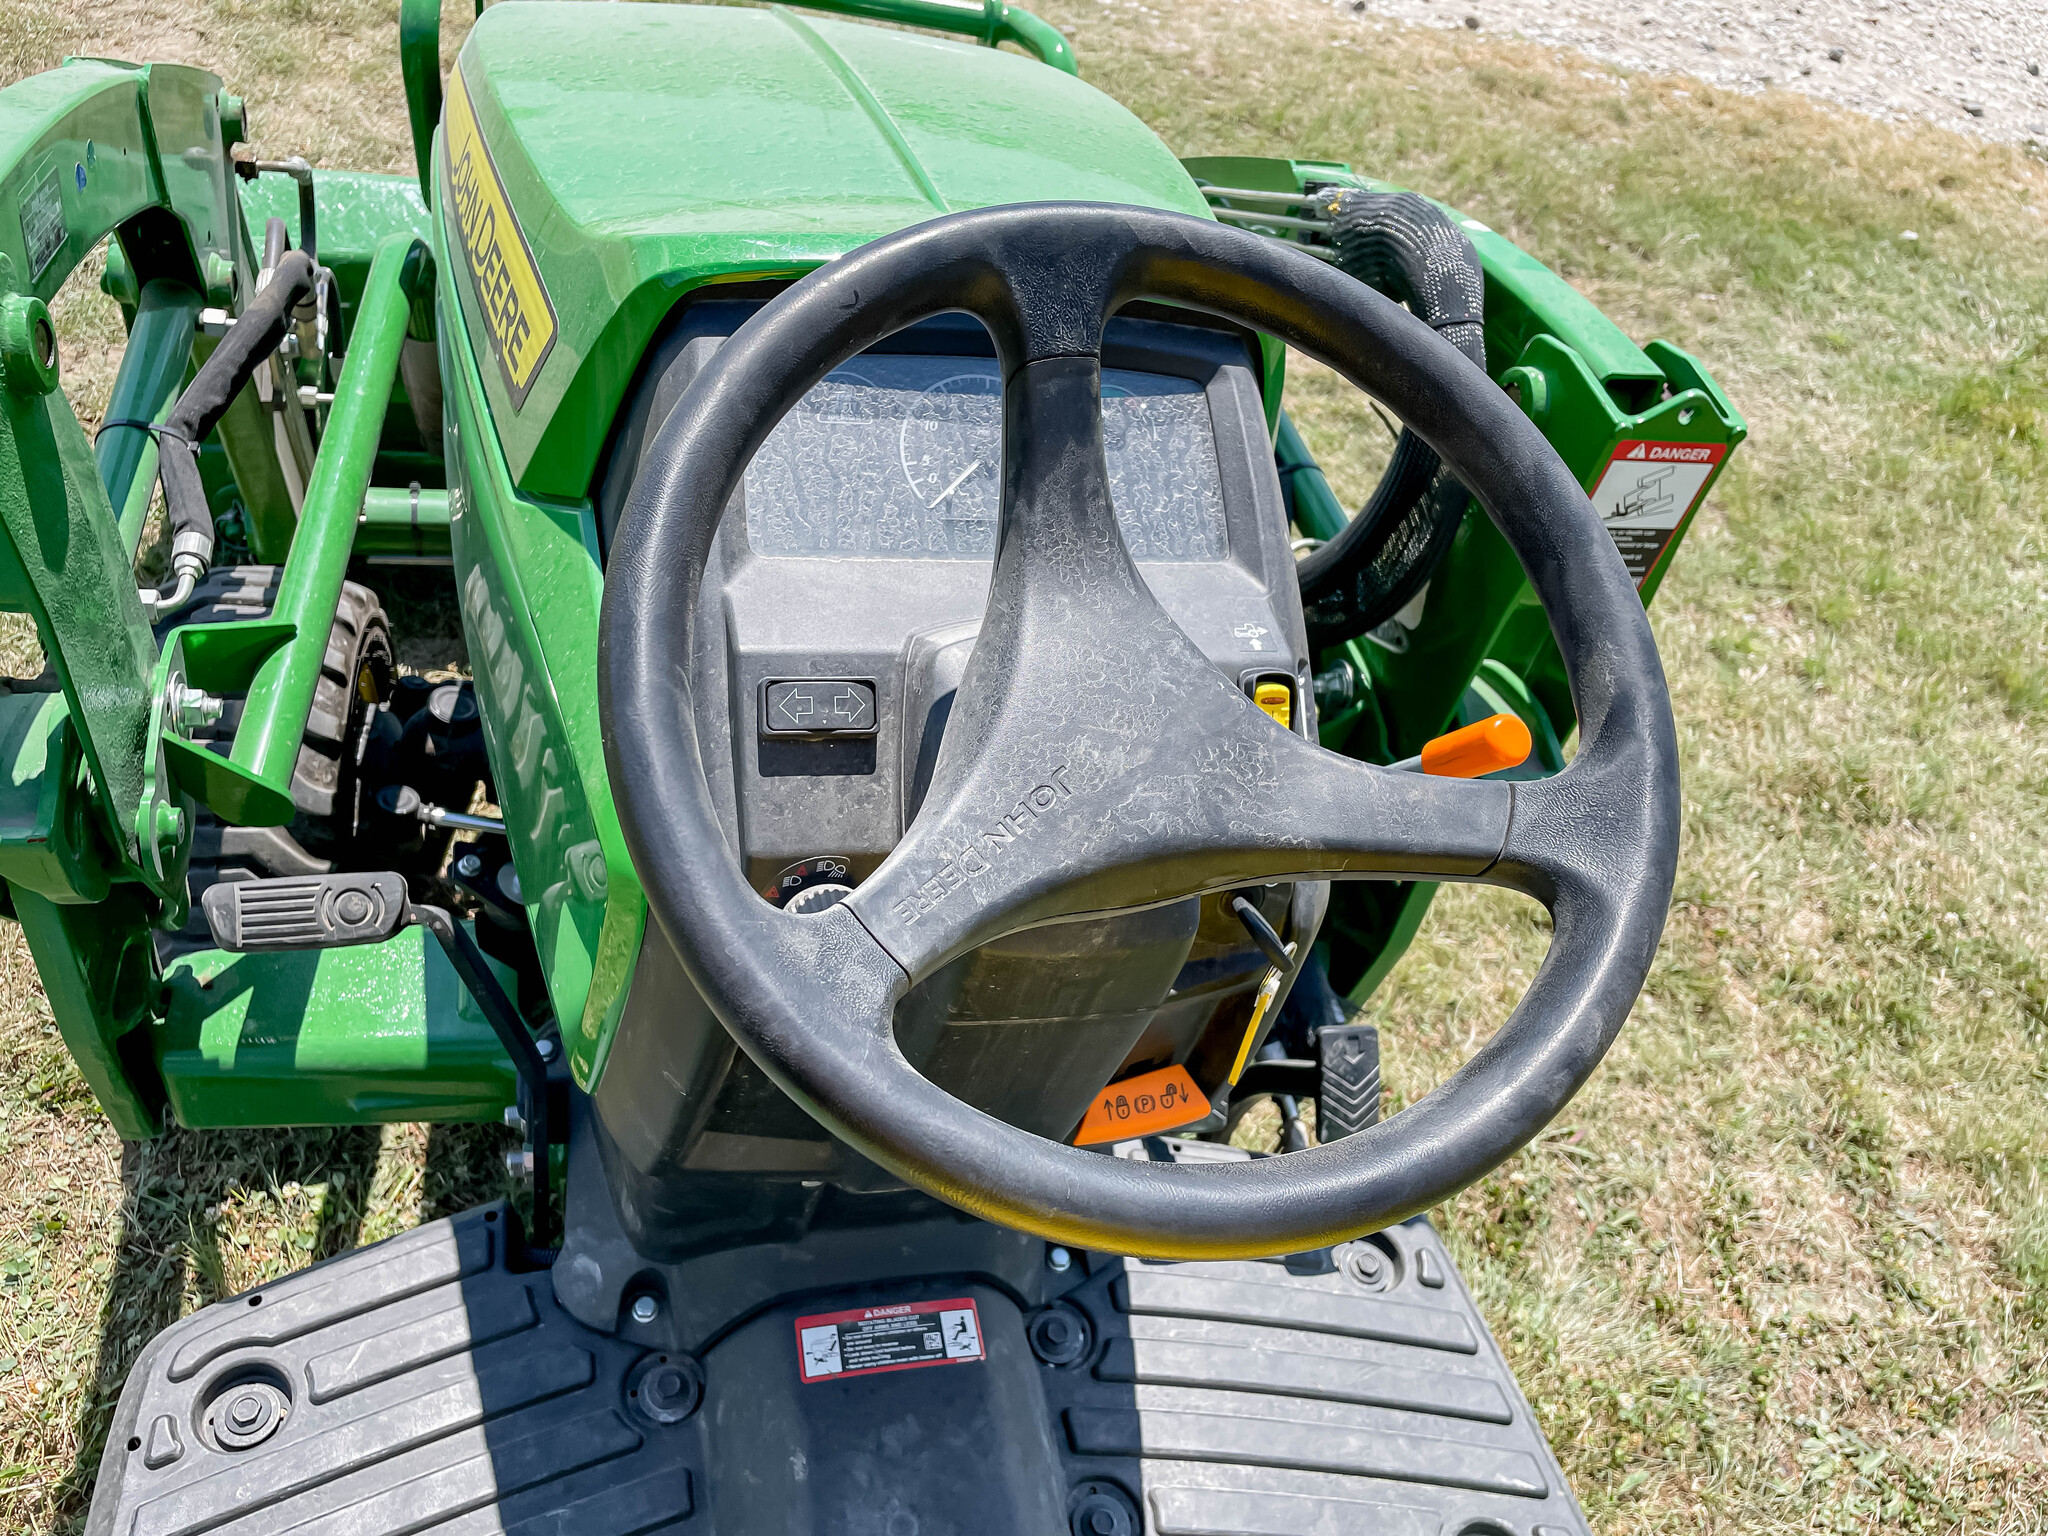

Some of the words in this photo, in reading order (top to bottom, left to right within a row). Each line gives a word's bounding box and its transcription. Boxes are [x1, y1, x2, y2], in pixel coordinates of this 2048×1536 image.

[453, 132, 484, 245] JOHN
[474, 203, 531, 376] DEERE
[924, 421, 938, 431] 10
[1648, 446, 1711, 461] DANGER
[983, 764, 1072, 852] JOHN
[893, 846, 992, 926] DEERE
[873, 1306, 912, 1317] DANGER
